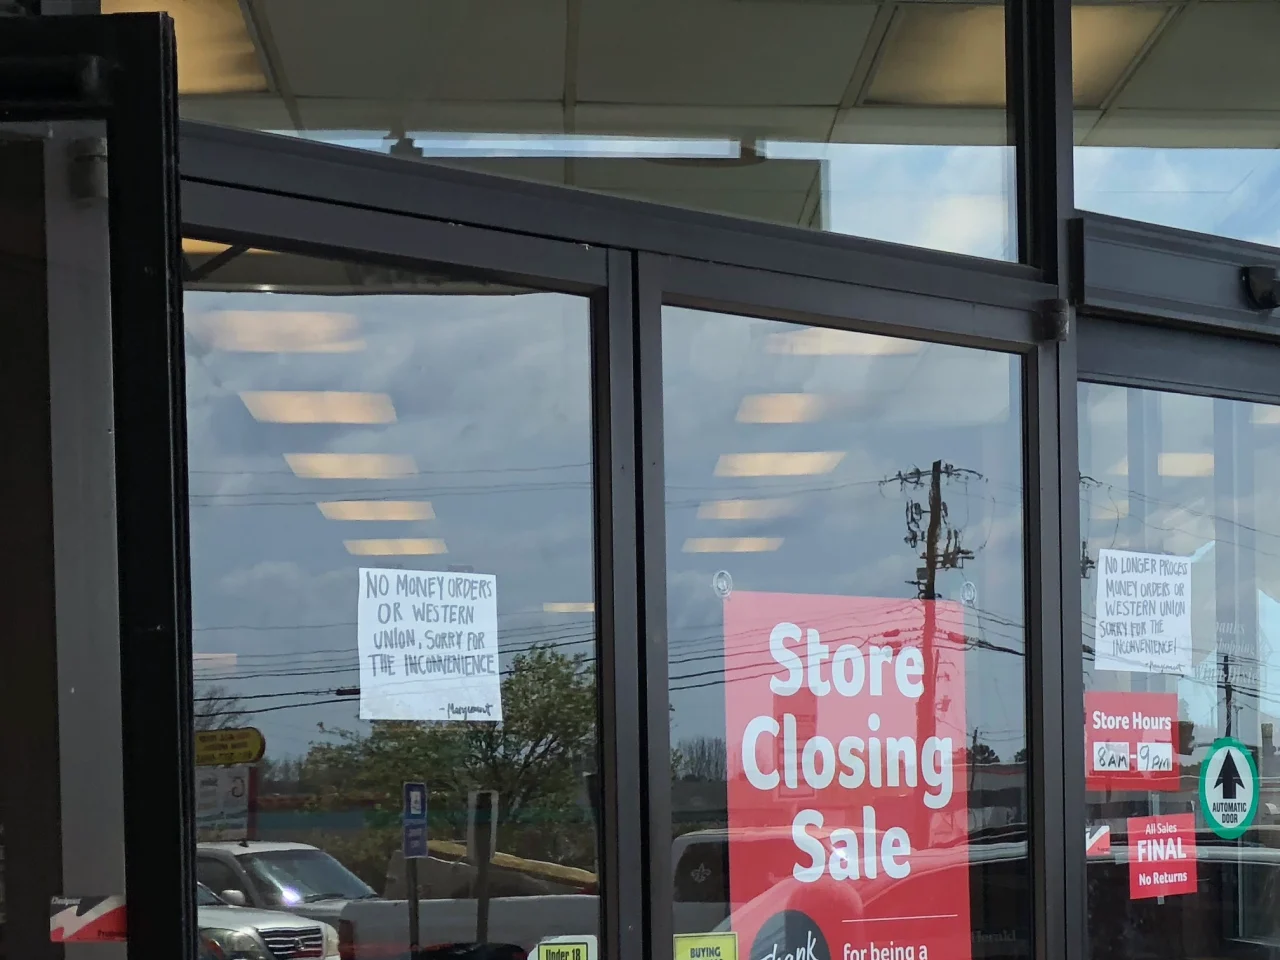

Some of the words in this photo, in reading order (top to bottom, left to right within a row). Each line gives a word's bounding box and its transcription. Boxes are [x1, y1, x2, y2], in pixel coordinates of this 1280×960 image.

[1105, 556, 1118, 575] NO
[1121, 556, 1156, 575] LONGER
[1159, 559, 1188, 576] PROCESS
[366, 571, 390, 598] NO
[396, 574, 444, 600] MONEY
[448, 578, 492, 600] ORDERS
[1106, 578, 1138, 598] MONEY
[1140, 582, 1170, 597] ORDERS
[1174, 582, 1185, 597] OR
[378, 602, 403, 624] OR
[412, 602, 474, 624] WESTERN
[1105, 599, 1156, 616] WESTERN
[1160, 599, 1186, 617] UNION
[1100, 620, 1128, 638] SORRY
[1130, 621, 1146, 638] FOR
[1150, 620, 1164, 634] THE
[424, 630, 463, 650] SORRY
[468, 632, 485, 651] FOR
[368, 654, 396, 677] THE
[404, 654, 496, 676] INCONVENIENCE
[769, 622, 924, 698] Store
[1092, 711, 1130, 730] Store
[1132, 712, 1172, 730] Hours
[742, 713, 952, 809] Closing
[1212, 802, 1247, 813] AUTOMATIC
[1222, 813, 1238, 824] DOOR
[1145, 823, 1156, 836] All
[1156, 822, 1178, 834] Sales
[792, 806, 911, 882] Sale
[1137, 837, 1187, 862] FINAL
[1138, 873, 1152, 886] No
[1154, 871, 1188, 884] Returns
[690, 946, 720, 958] BUYING
[919, 945, 928, 960] a
